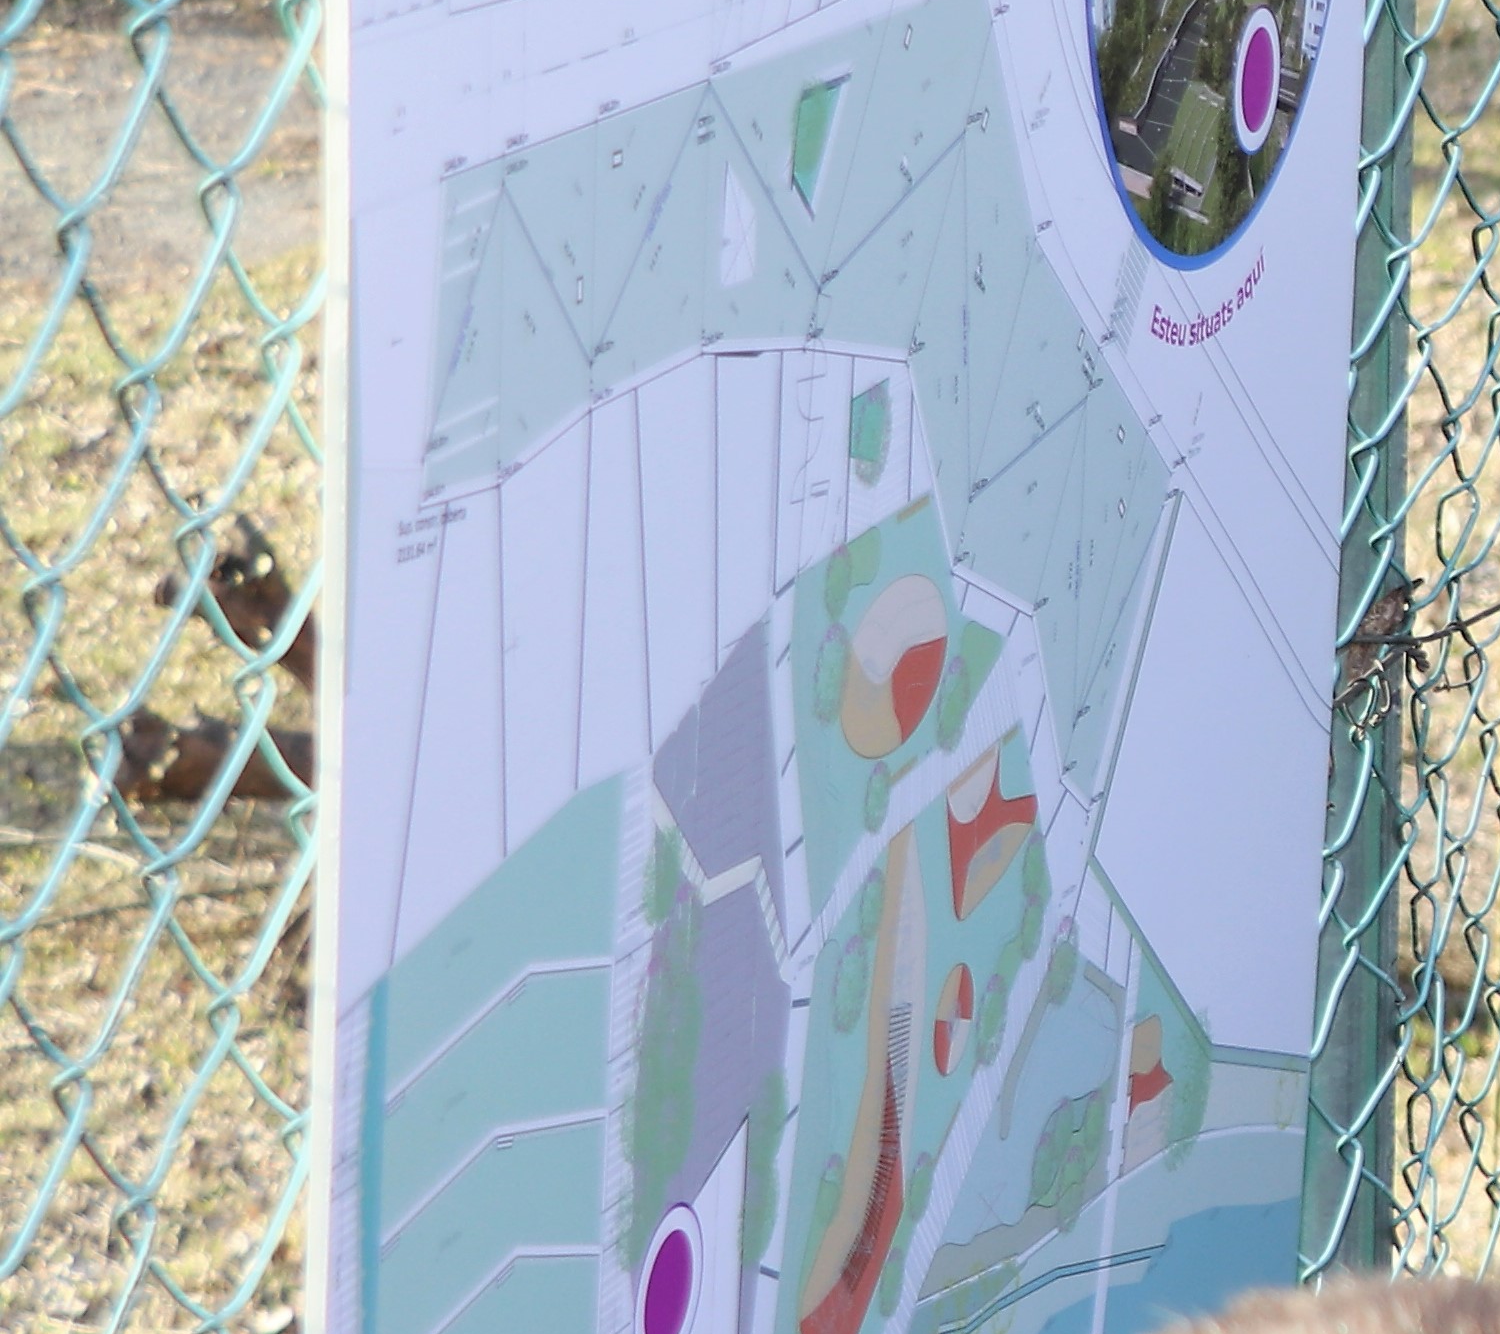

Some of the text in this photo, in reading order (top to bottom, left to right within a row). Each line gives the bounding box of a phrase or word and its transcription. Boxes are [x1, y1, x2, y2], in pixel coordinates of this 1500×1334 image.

[1149, 243, 1266, 347] Esteu situats aquí
